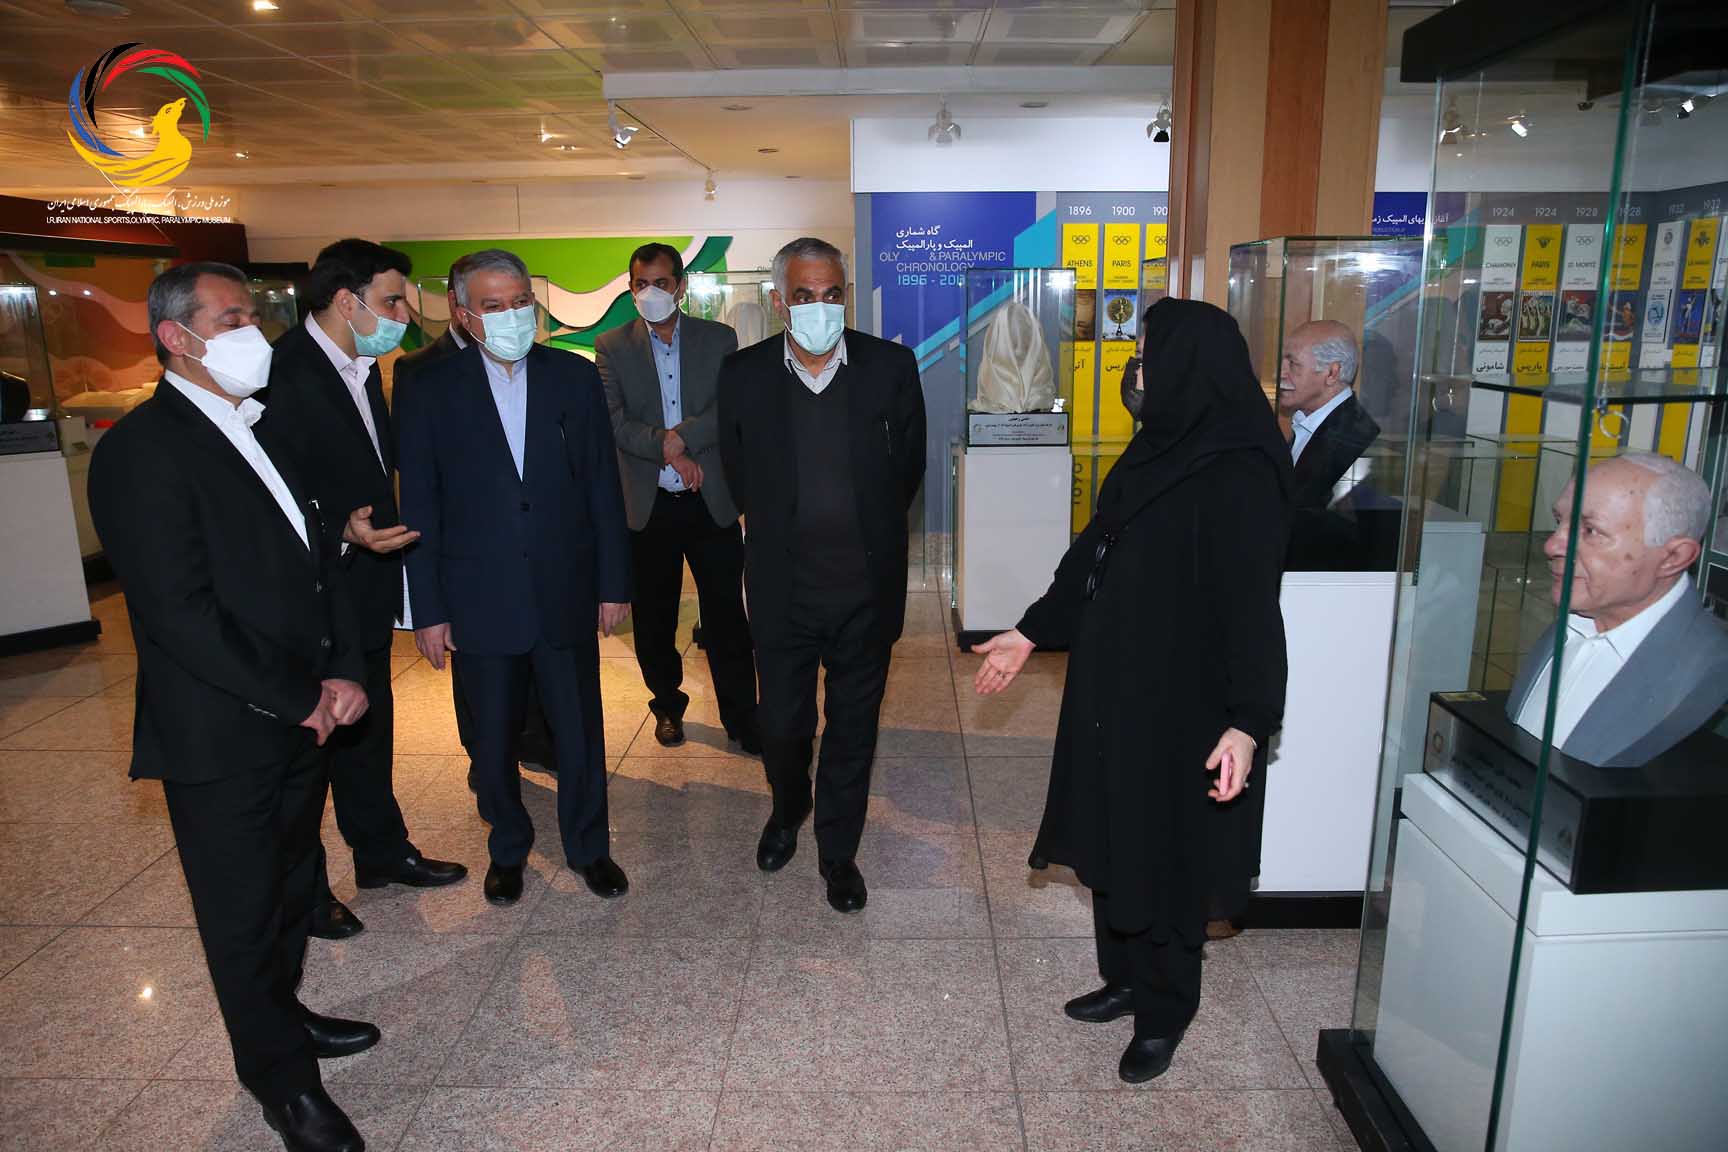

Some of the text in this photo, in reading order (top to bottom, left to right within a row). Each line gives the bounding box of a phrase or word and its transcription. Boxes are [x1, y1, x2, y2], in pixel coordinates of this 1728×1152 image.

[1068, 206, 1092, 216] 1896
[1112, 206, 1136, 216] 1900
[1152, 206, 1168, 216] 190
[1492, 207, 1515, 217] 1924
[1535, 207, 1557, 217] 1924
[1383, 214, 1408, 224] المپیک
[896, 224, 941, 238] گاه شماری
[896, 239, 938, 252] پارالمپیک
[944, 239, 973, 251] المپیک
[929, 252, 937, 261] &
[939, 251, 1006, 261] PARALYMPIC
[896, 262, 975, 272] CHRONOLOGY
[1067, 259, 1093, 268] ATHENS
[1112, 259, 1132, 268] PARIS
[898, 274, 928, 286] 1896
